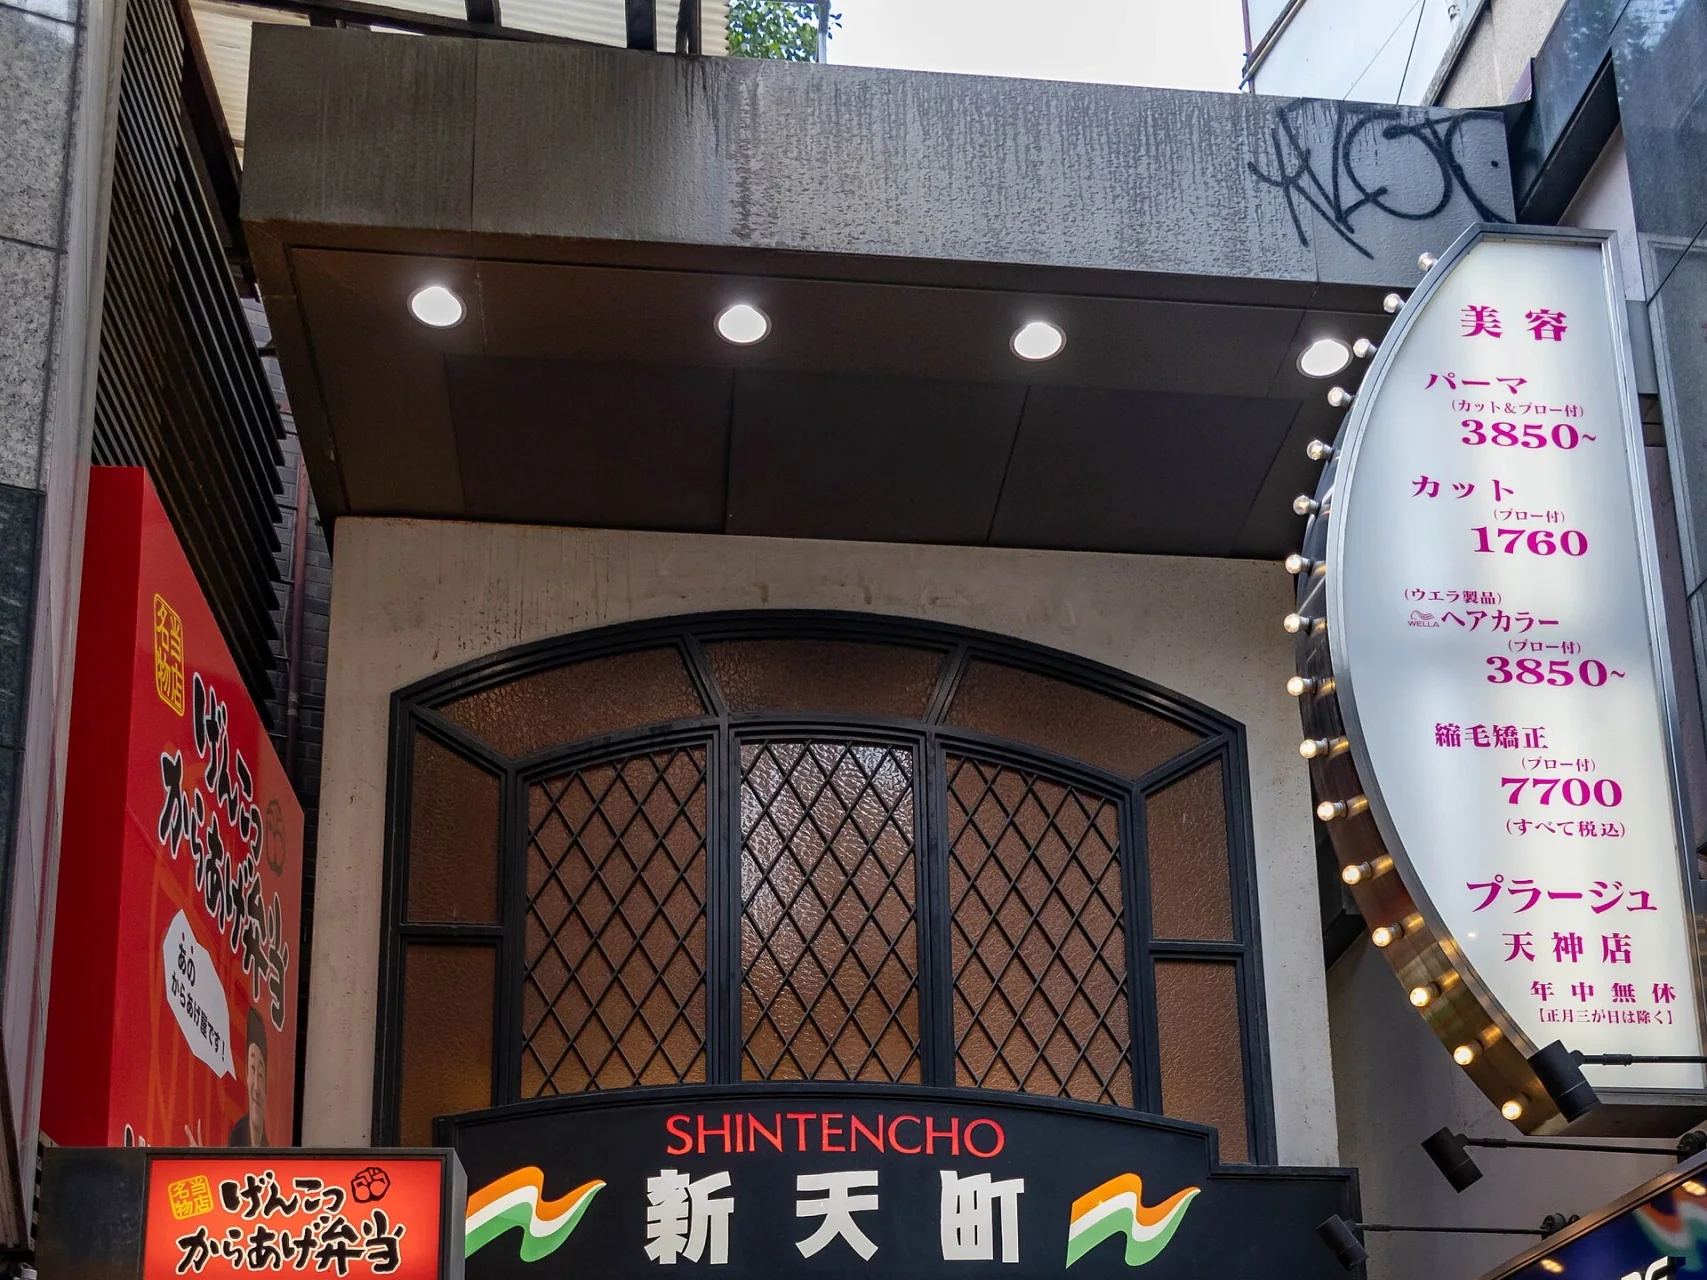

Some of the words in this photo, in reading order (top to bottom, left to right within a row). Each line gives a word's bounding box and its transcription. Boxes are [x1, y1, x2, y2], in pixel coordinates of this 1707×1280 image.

[1460, 304, 1568, 342] 美容
[1424, 371, 1528, 395] パーマ
[1411, 475, 1515, 502] カット
[1470, 526, 1589, 557] 1760
[1407, 619, 1440, 629] WELLA
[1441, 609, 1559, 635] ヘアカラー
[1434, 722, 1549, 750] 縮毛矯正
[192, 671, 263, 866] げんこつ
[1500, 777, 1623, 808] 7700
[158, 750, 289, 1032] からあげ弁当
[1465, 873, 1658, 915] プラージュ
[177, 943, 197, 987] あの
[1502, 931, 1633, 965] 天神店
[1530, 981, 1677, 1004] 年中無休
[666, 1112, 1006, 1157] SHINTENCHO
[218, 1169, 347, 1220] げんこつ
[645, 1168, 1025, 1266] 新天町
[175, 1208, 406, 1277] からあげ弁当
